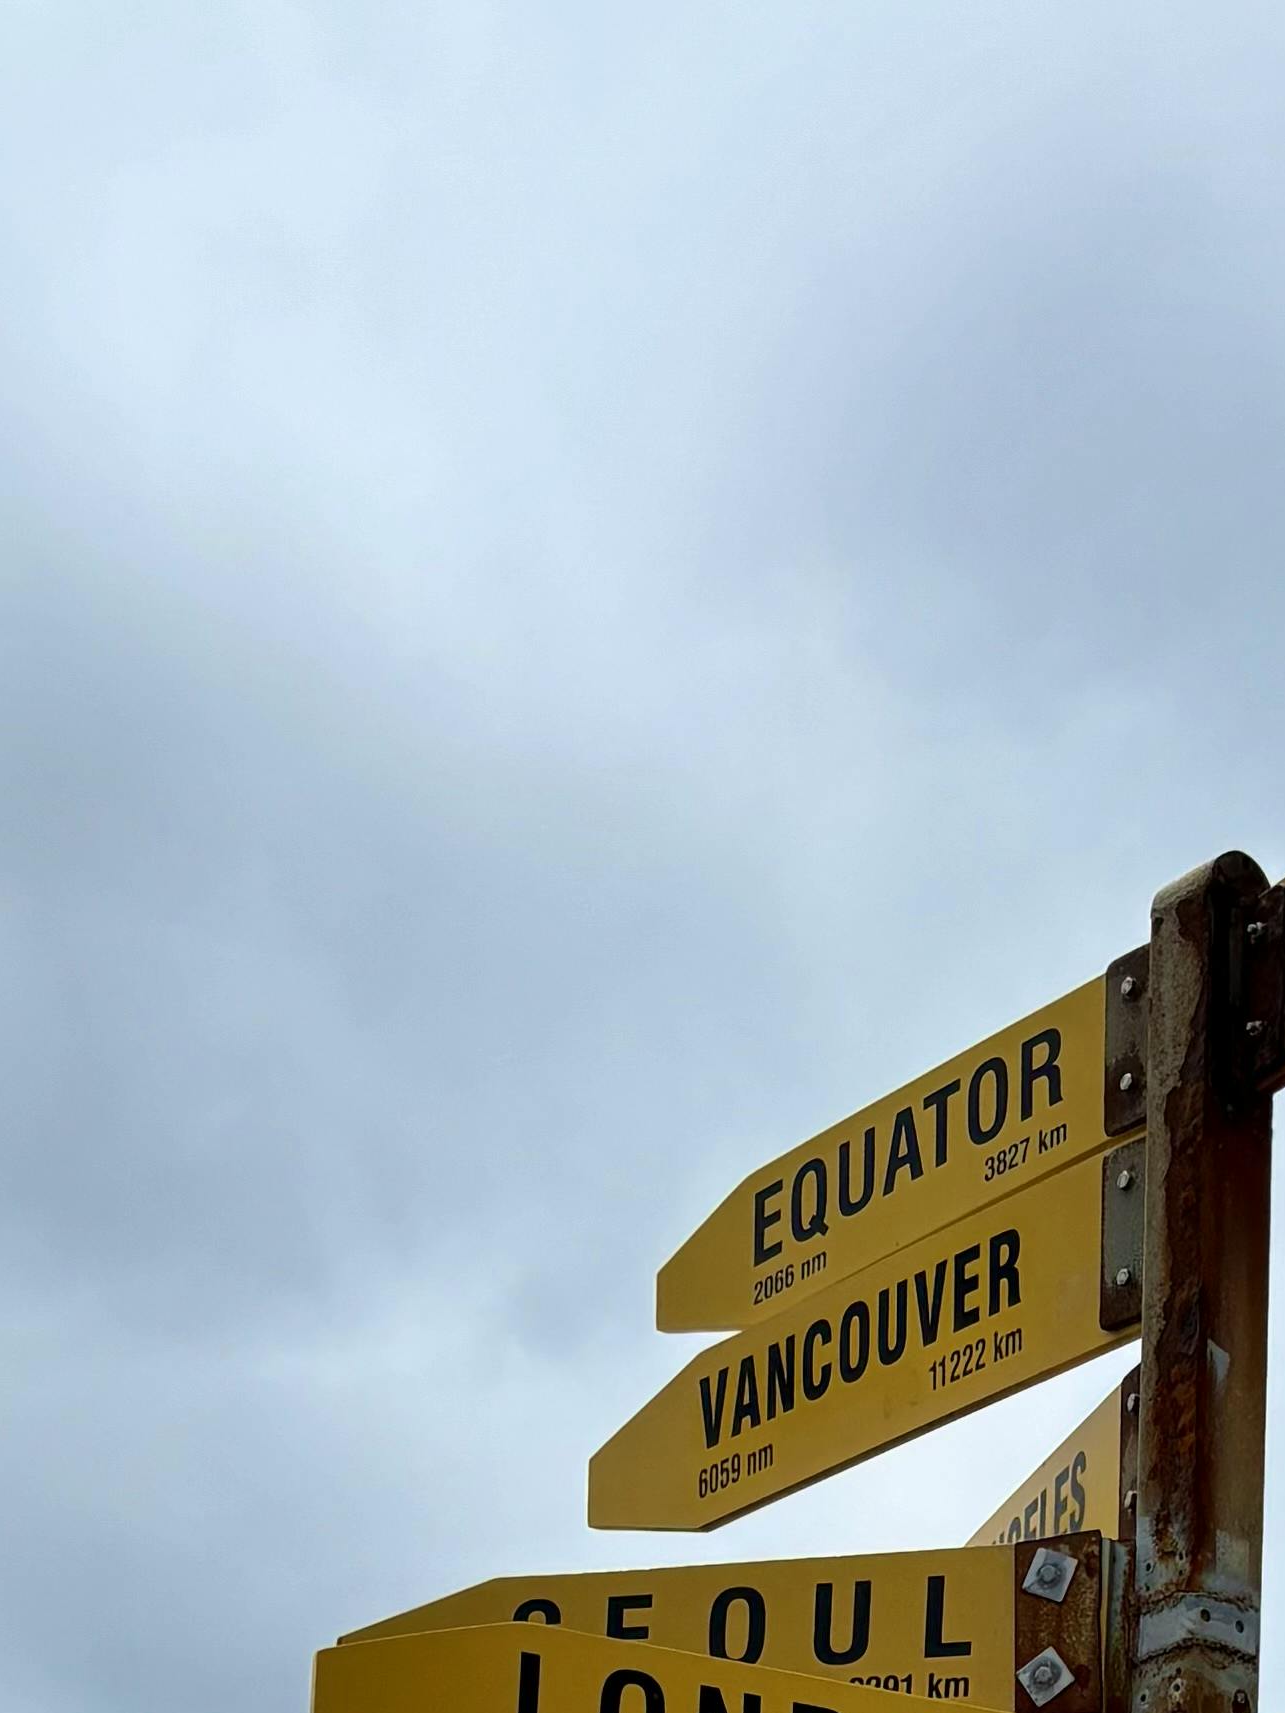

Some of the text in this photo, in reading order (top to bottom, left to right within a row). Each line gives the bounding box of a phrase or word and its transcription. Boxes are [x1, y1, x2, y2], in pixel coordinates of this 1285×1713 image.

[753, 1027, 1065, 1269] EQUATOR
[983, 1122, 1068, 1183] 3827 km
[752, 1250, 828, 1307] 2066 nm
[698, 1228, 1023, 1451] VANCOUVER
[927, 1326, 1023, 1392] 11222 km
[697, 1443, 775, 1500] 6059 nm
[927, 1671, 971, 1700] km
